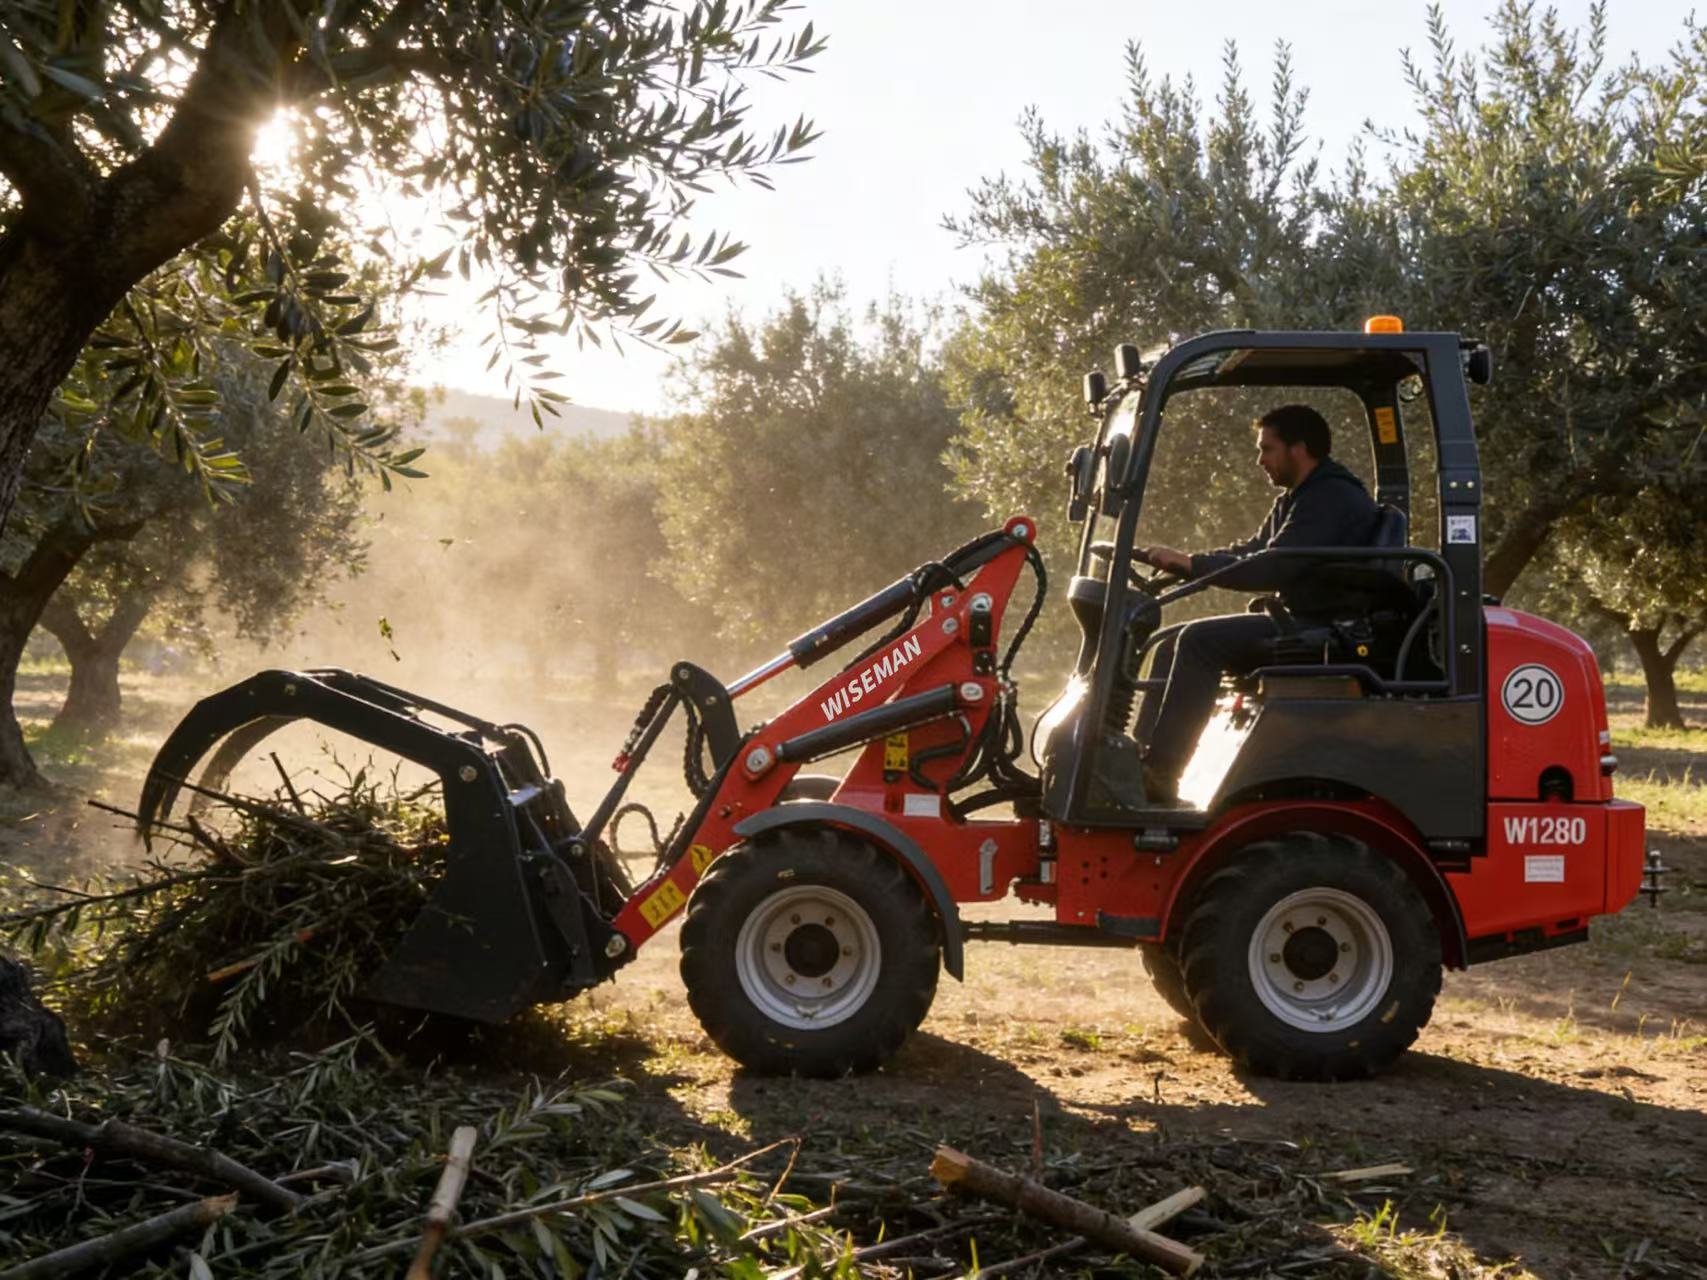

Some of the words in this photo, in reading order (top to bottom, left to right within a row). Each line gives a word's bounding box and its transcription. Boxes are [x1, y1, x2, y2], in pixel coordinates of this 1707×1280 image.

[820, 633, 922, 722] WISEMAN
[1512, 678, 1555, 709] 20
[1504, 817, 1586, 844] W1280
